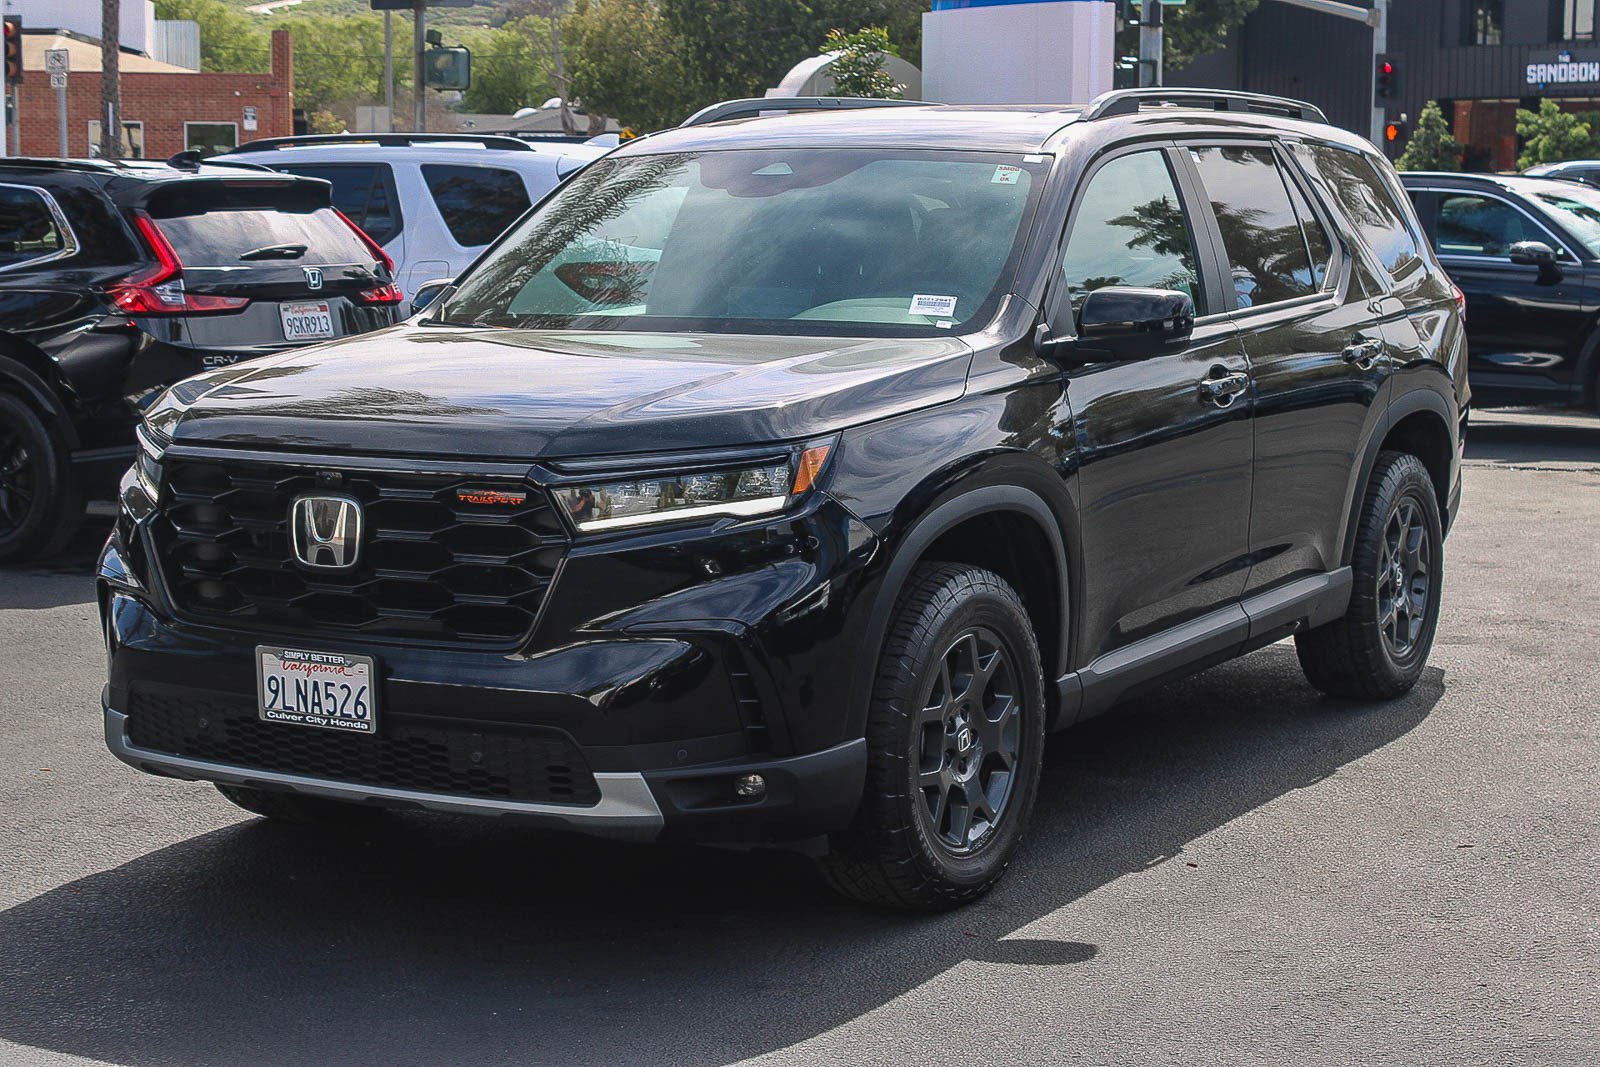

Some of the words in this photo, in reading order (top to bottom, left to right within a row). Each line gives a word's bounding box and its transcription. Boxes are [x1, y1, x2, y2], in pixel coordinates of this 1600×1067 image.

[1526, 62, 1600, 84] SANDBOX
[286, 315, 330, 335] 9GKR913
[202, 355, 238, 365] CR-V
[458, 494, 525, 505] TRAILSPORT
[283, 650, 310, 661] SIMPLY
[310, 654, 345, 665] BETTER
[267, 675, 368, 720] 9LNA526
[266, 711, 304, 721] Culver
[305, 715, 328, 726] City
[330, 717, 368, 730] Honda
